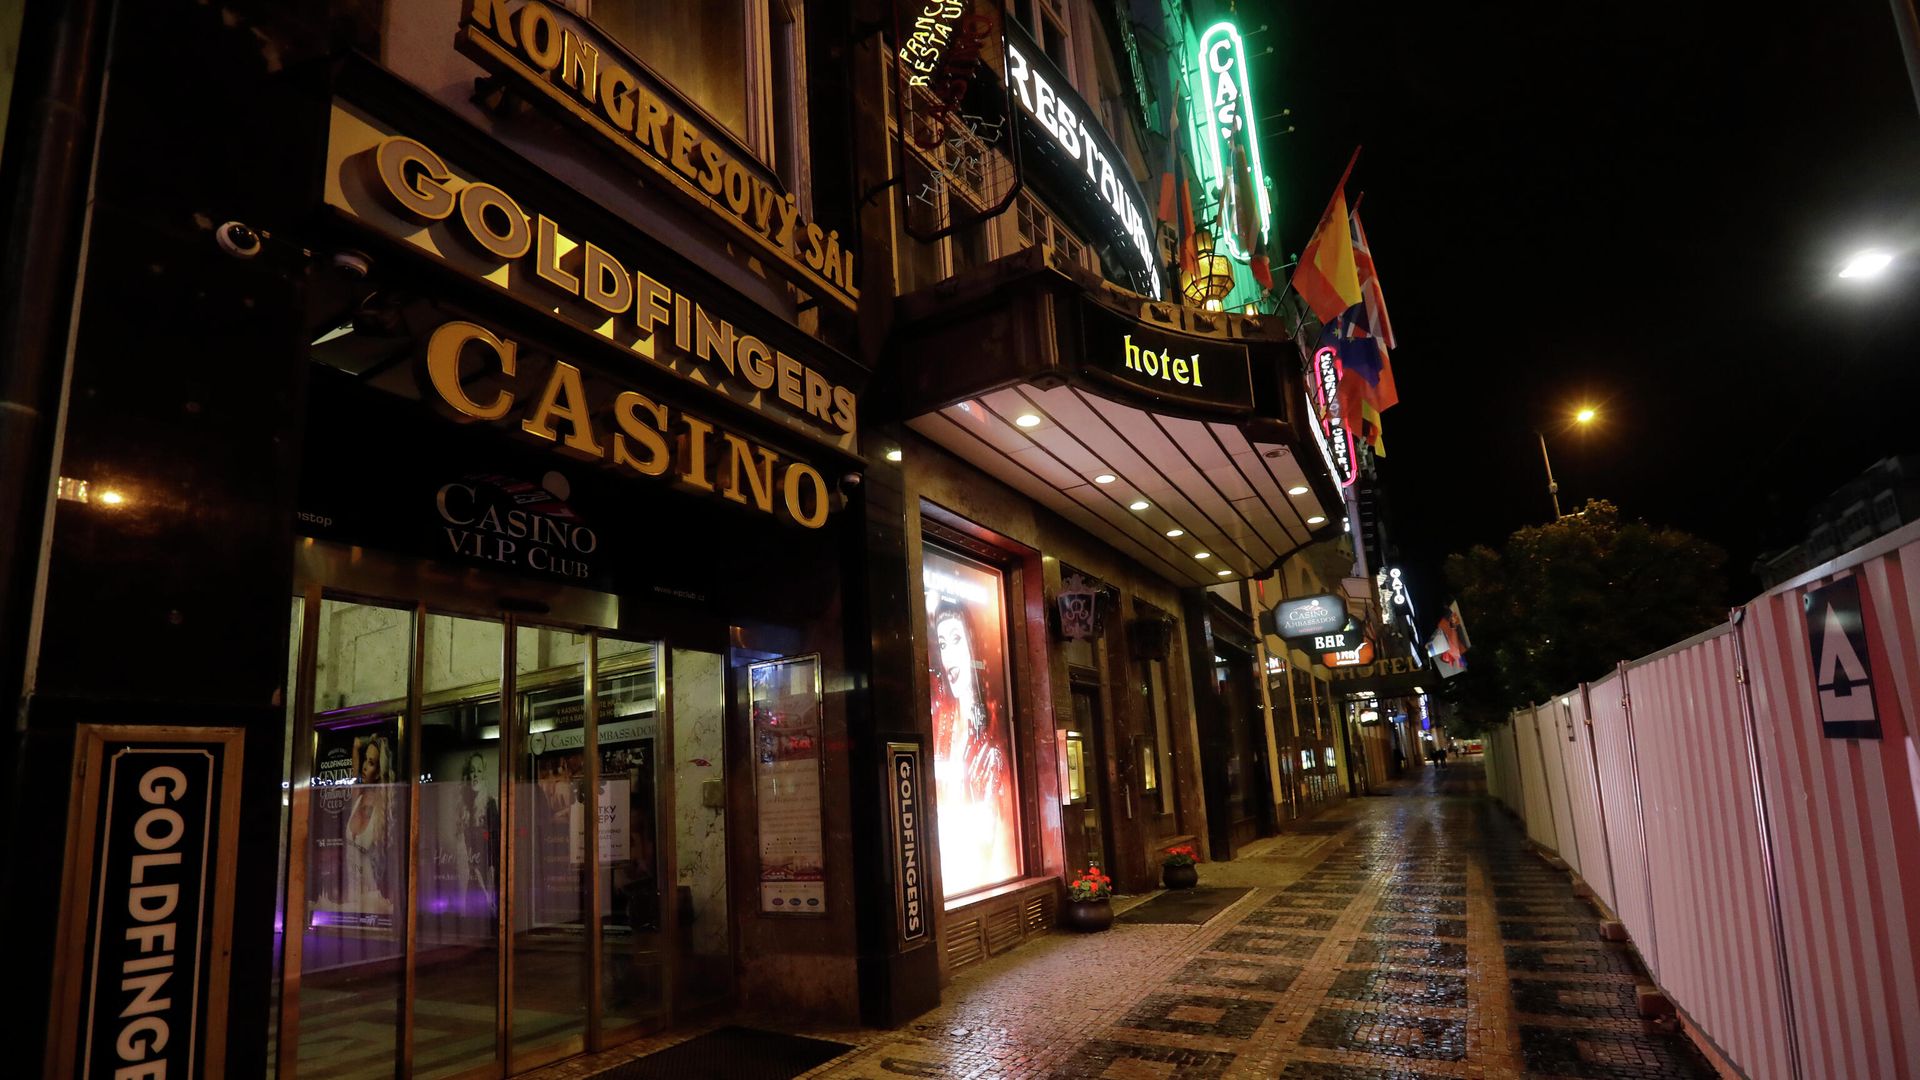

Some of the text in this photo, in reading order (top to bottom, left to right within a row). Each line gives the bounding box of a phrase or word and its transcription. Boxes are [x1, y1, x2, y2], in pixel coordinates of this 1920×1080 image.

[900, 0, 945, 63] FRANC
[1209, 39, 1243, 140] CAS
[376, 135, 856, 434] GOLDFINGERS
[1124, 335, 1203, 387] hotel
[427, 321, 829, 529] CASINO
[436, 482, 597, 554] CASINO
[528, 546, 590, 579] CLUB
[1289, 608, 1328, 621] CASINO
[1315, 634, 1345, 649] BAR
[900, 761, 919, 931] GOLDFINGERS
